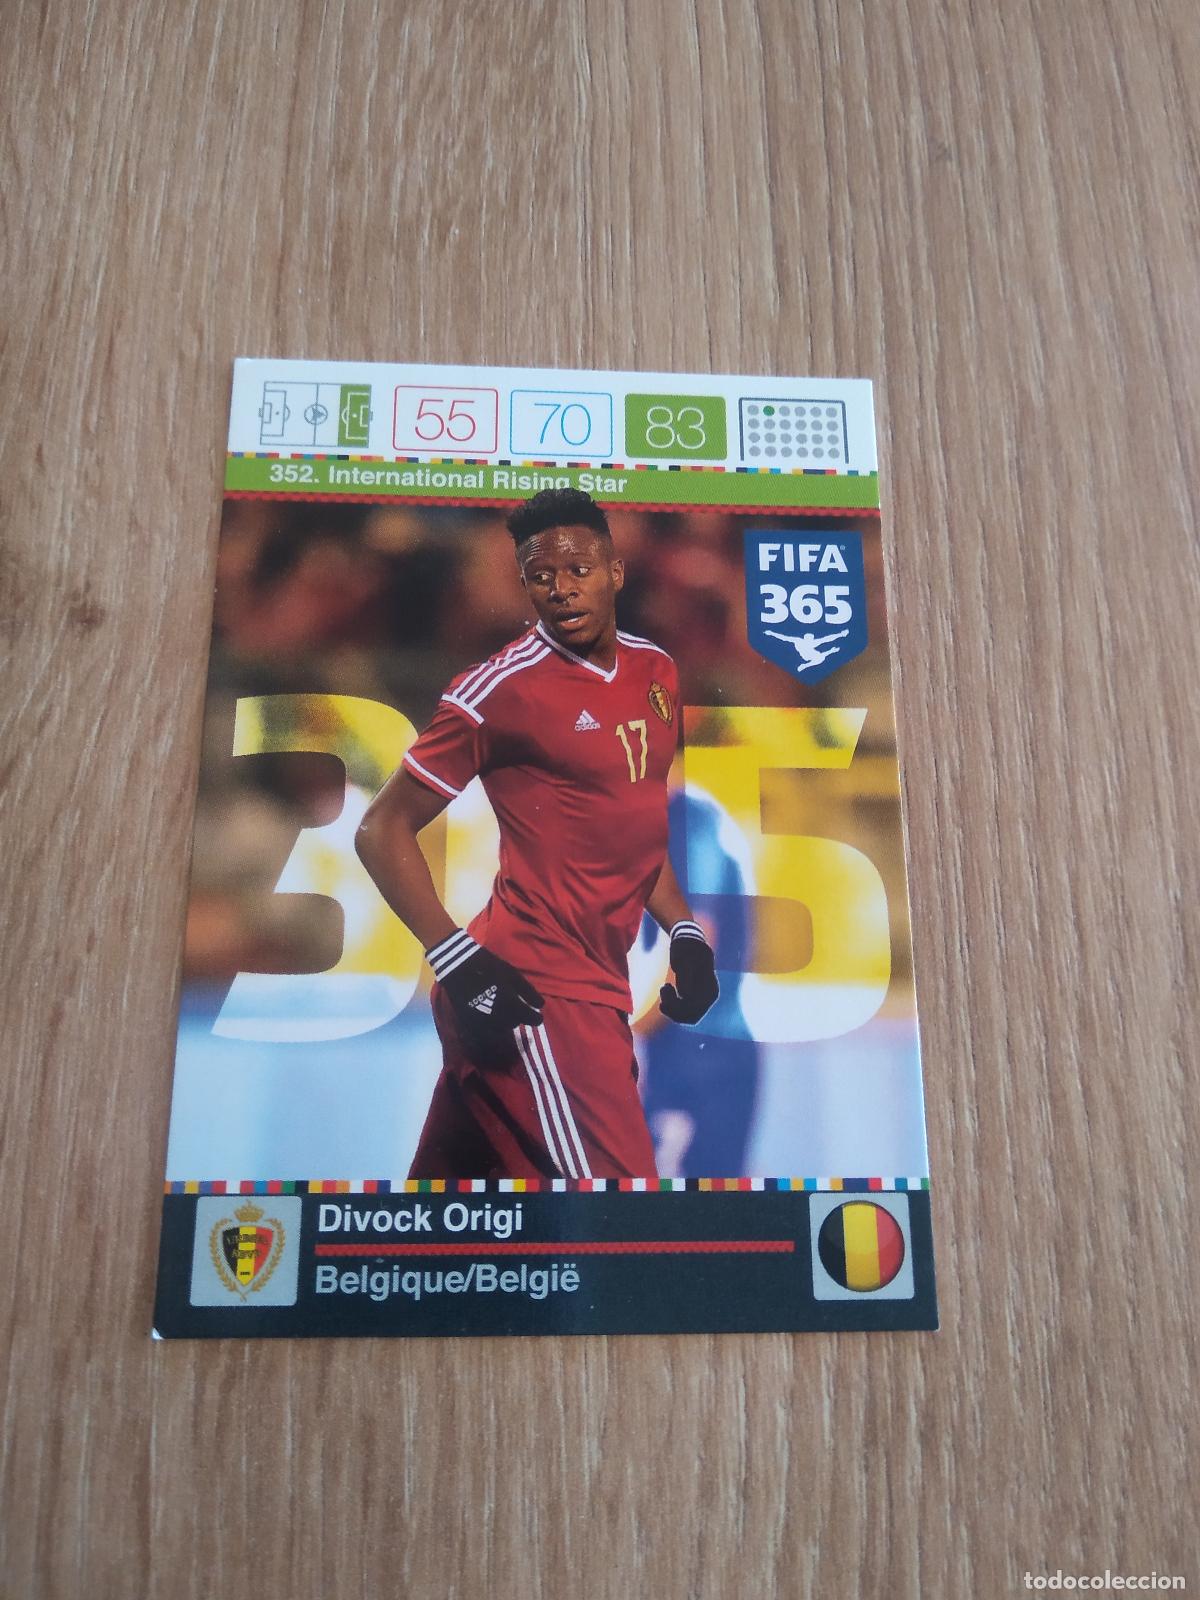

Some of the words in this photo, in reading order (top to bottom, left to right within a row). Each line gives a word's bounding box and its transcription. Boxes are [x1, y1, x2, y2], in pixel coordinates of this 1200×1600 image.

[414, 398, 476, 442] 55
[533, 402, 592, 446] 70
[645, 405, 707, 450] 83
[270, 463, 320, 484] 352.
[328, 465, 485, 489] International
[578, 473, 628, 494] Star
[758, 543, 849, 573] FIFA
[759, 583, 853, 625] 365
[615, 719, 648, 783] 17
[318, 1203, 433, 1232] Divock
[443, 1202, 523, 1239] Origi
[315, 1263, 580, 1301] Belgique/België
